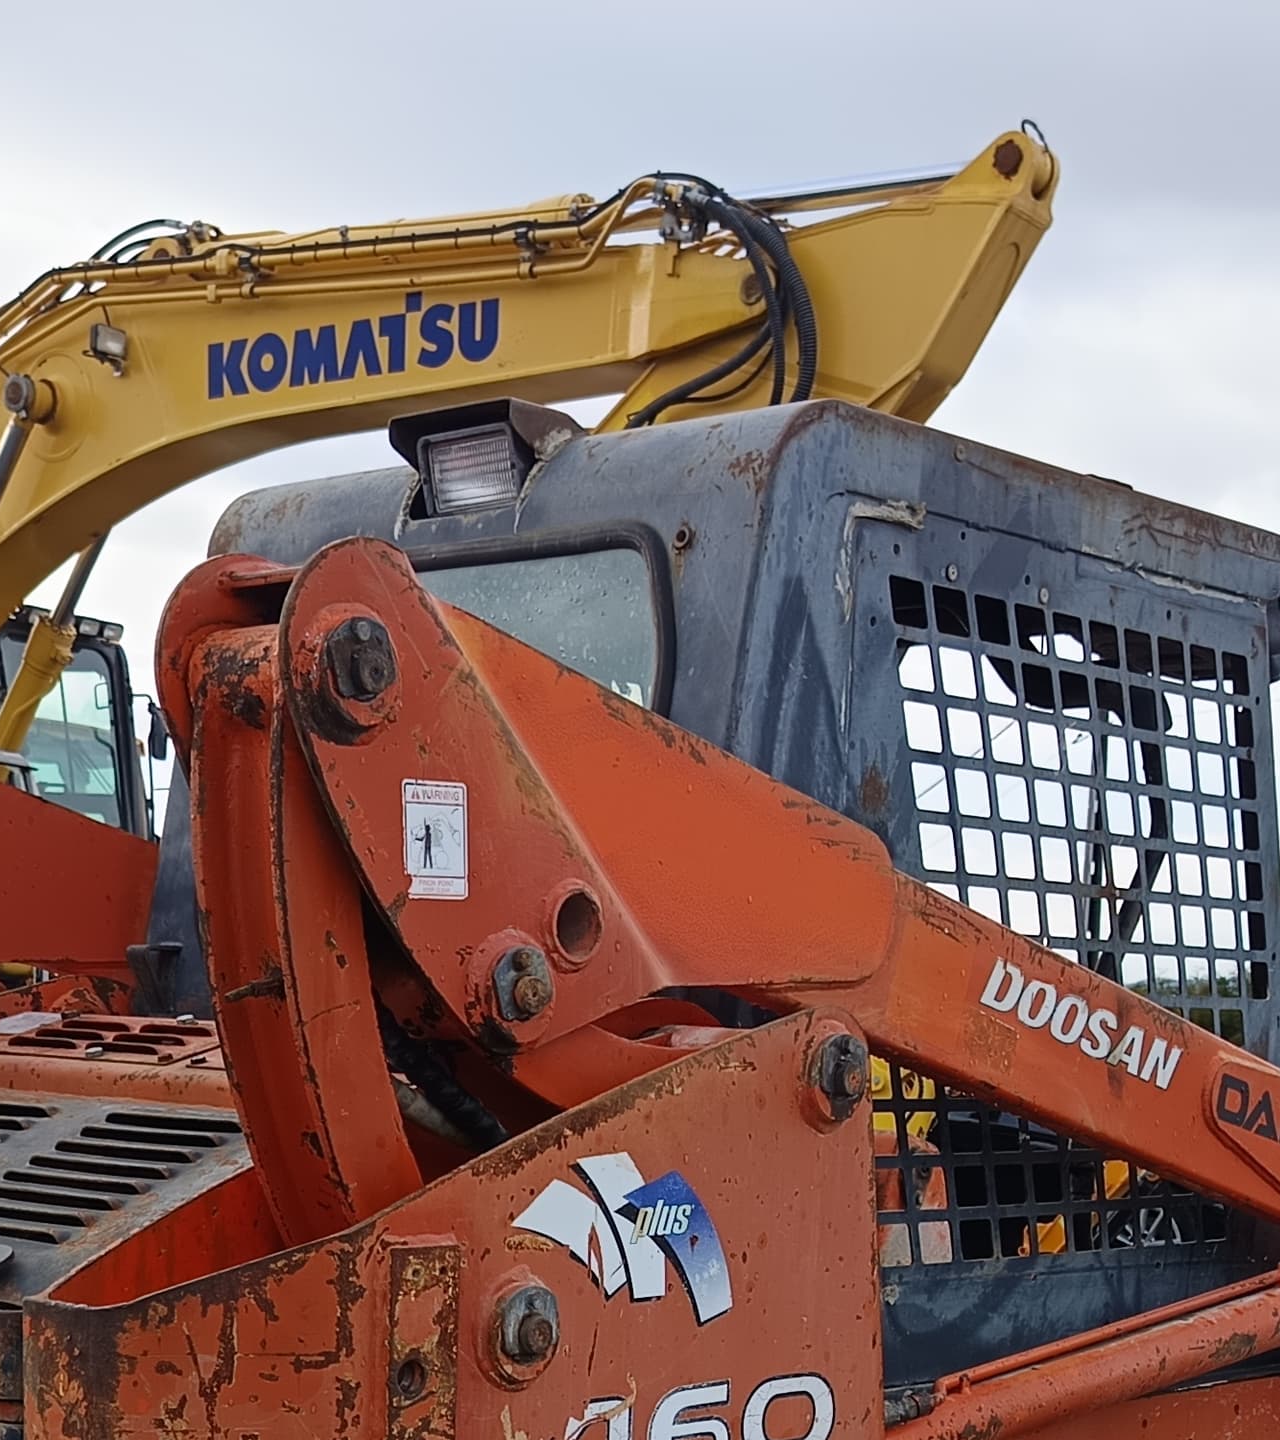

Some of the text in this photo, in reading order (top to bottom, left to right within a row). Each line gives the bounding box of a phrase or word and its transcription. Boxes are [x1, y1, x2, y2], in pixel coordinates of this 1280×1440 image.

[208, 291, 500, 400] KOMATSU
[978, 956, 1184, 1091] DOOSAN
[630, 1198, 692, 1245] plus
